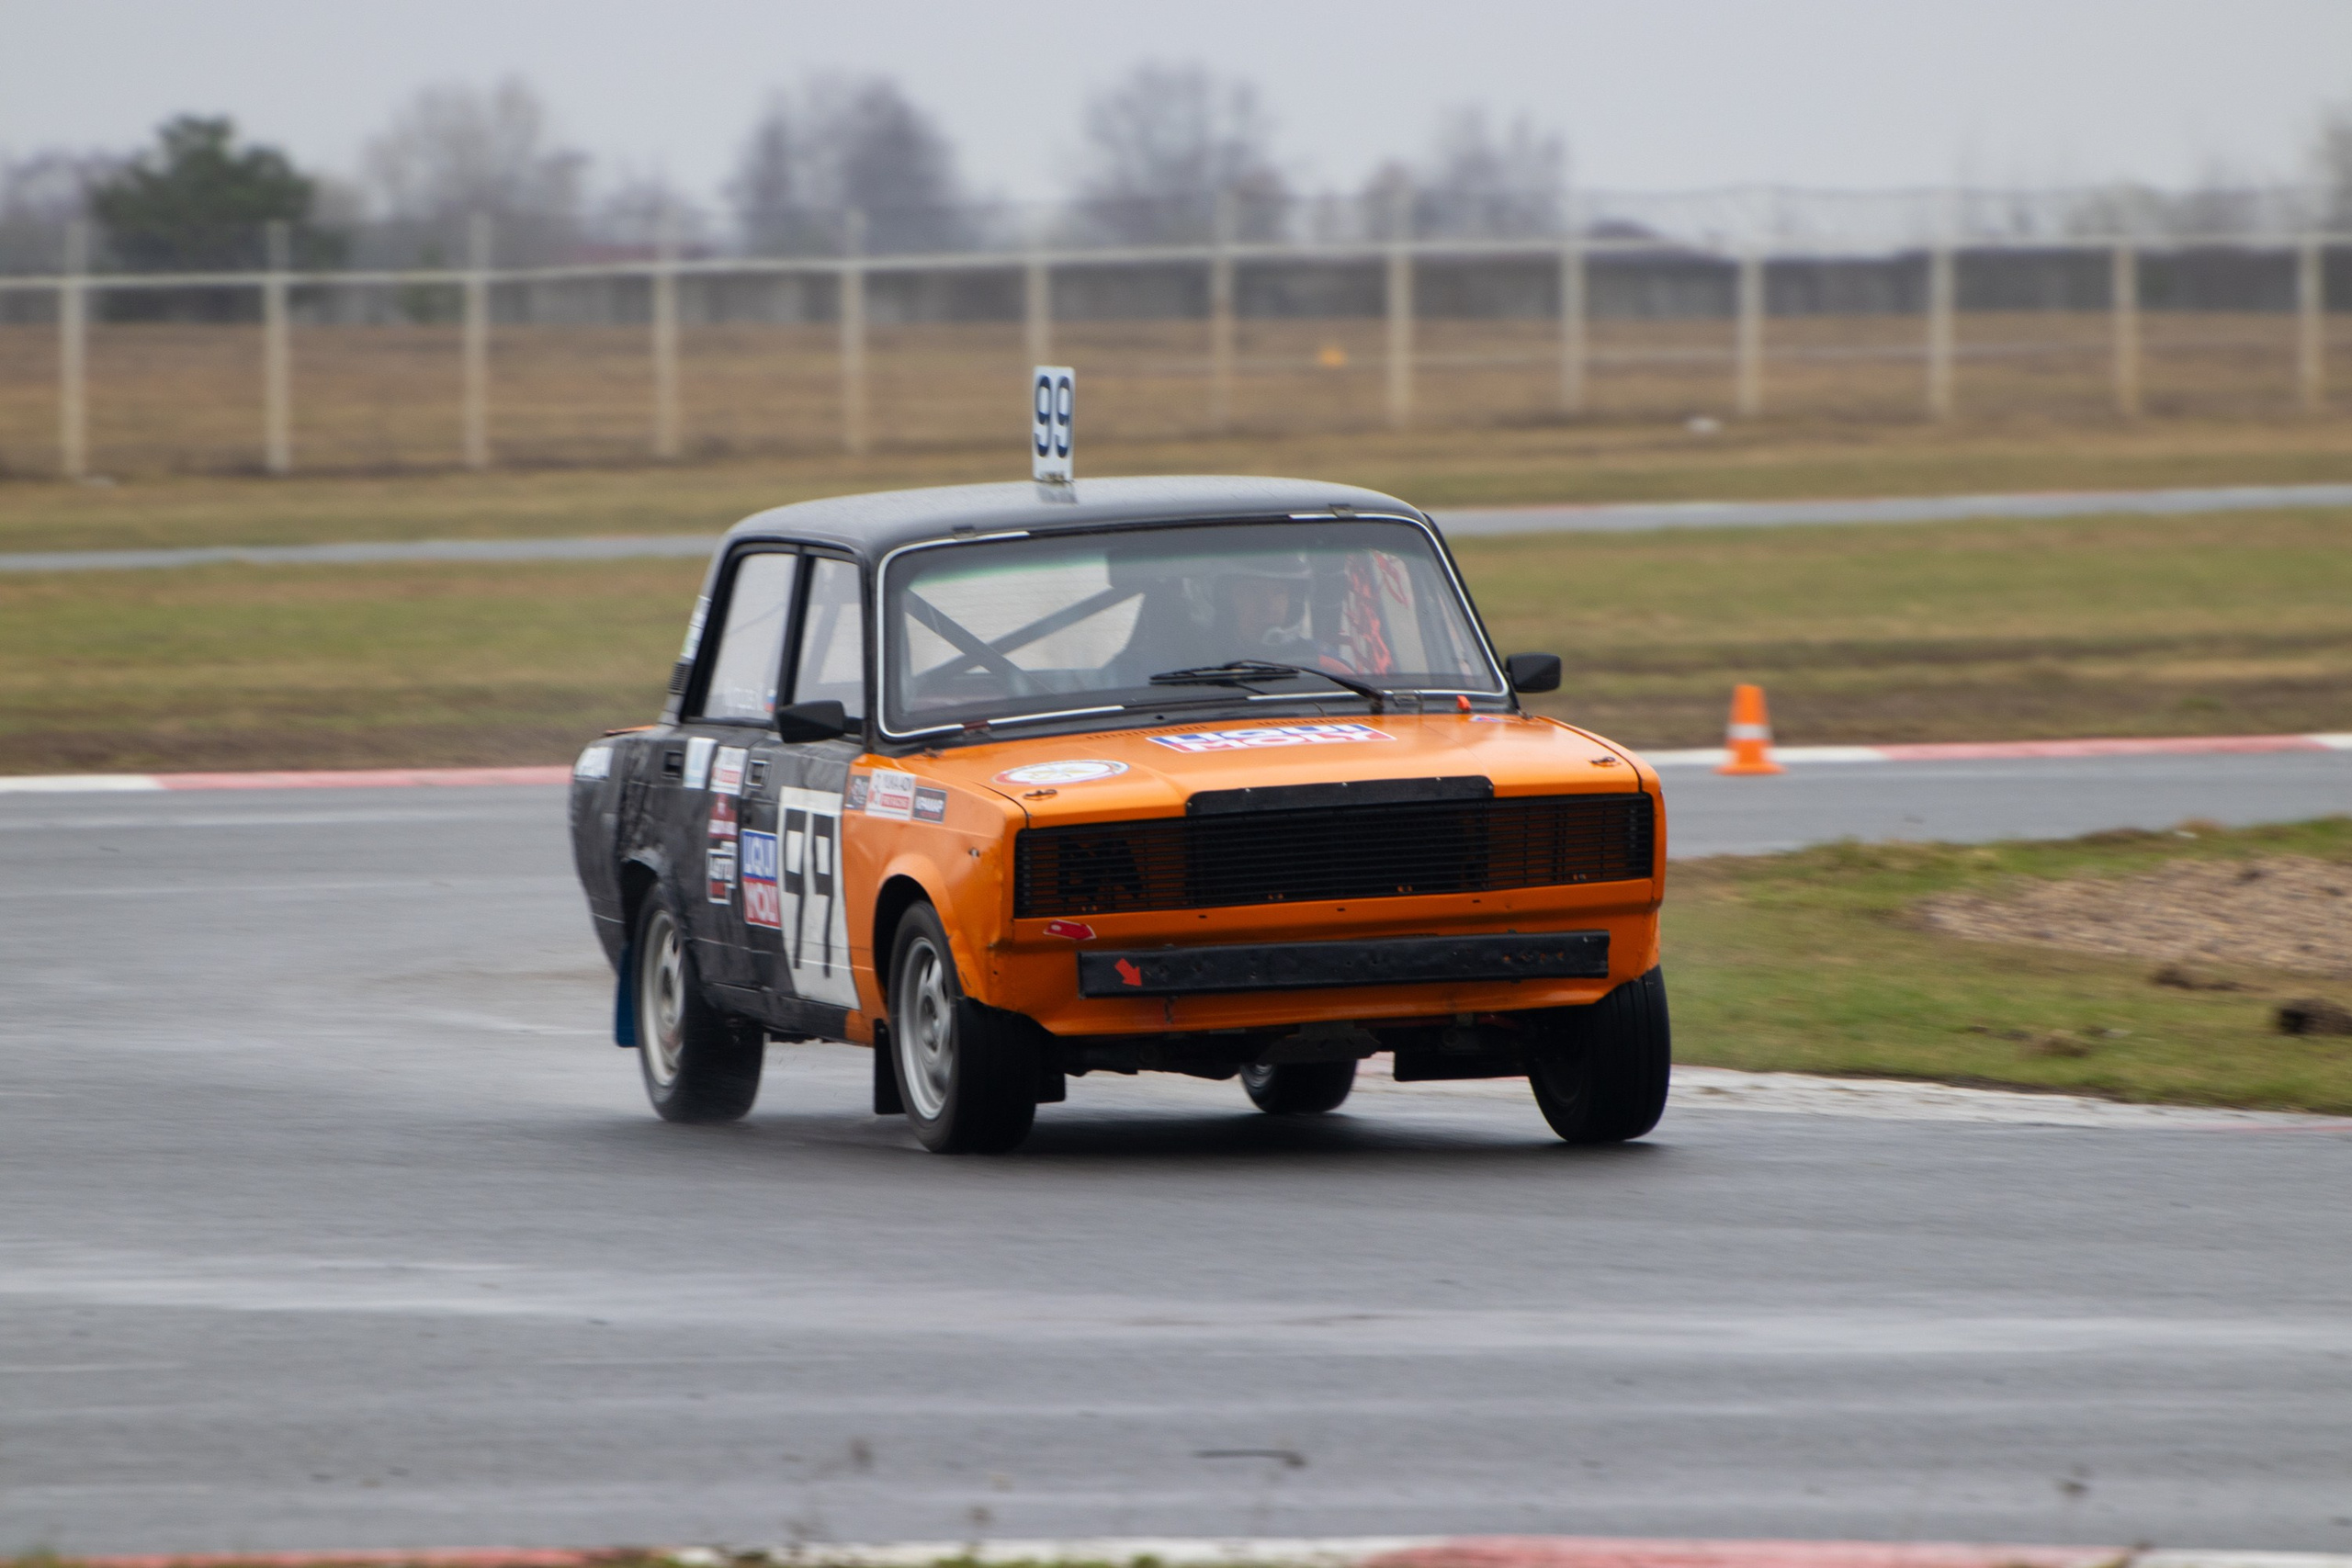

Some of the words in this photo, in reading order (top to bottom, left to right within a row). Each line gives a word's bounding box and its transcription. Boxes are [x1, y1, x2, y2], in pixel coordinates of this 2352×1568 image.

[1035, 375, 1072, 457] 99
[1160, 724, 1368, 745] LIQUI
[1182, 731, 1376, 752] MOLY
[784, 808, 834, 978] 99
